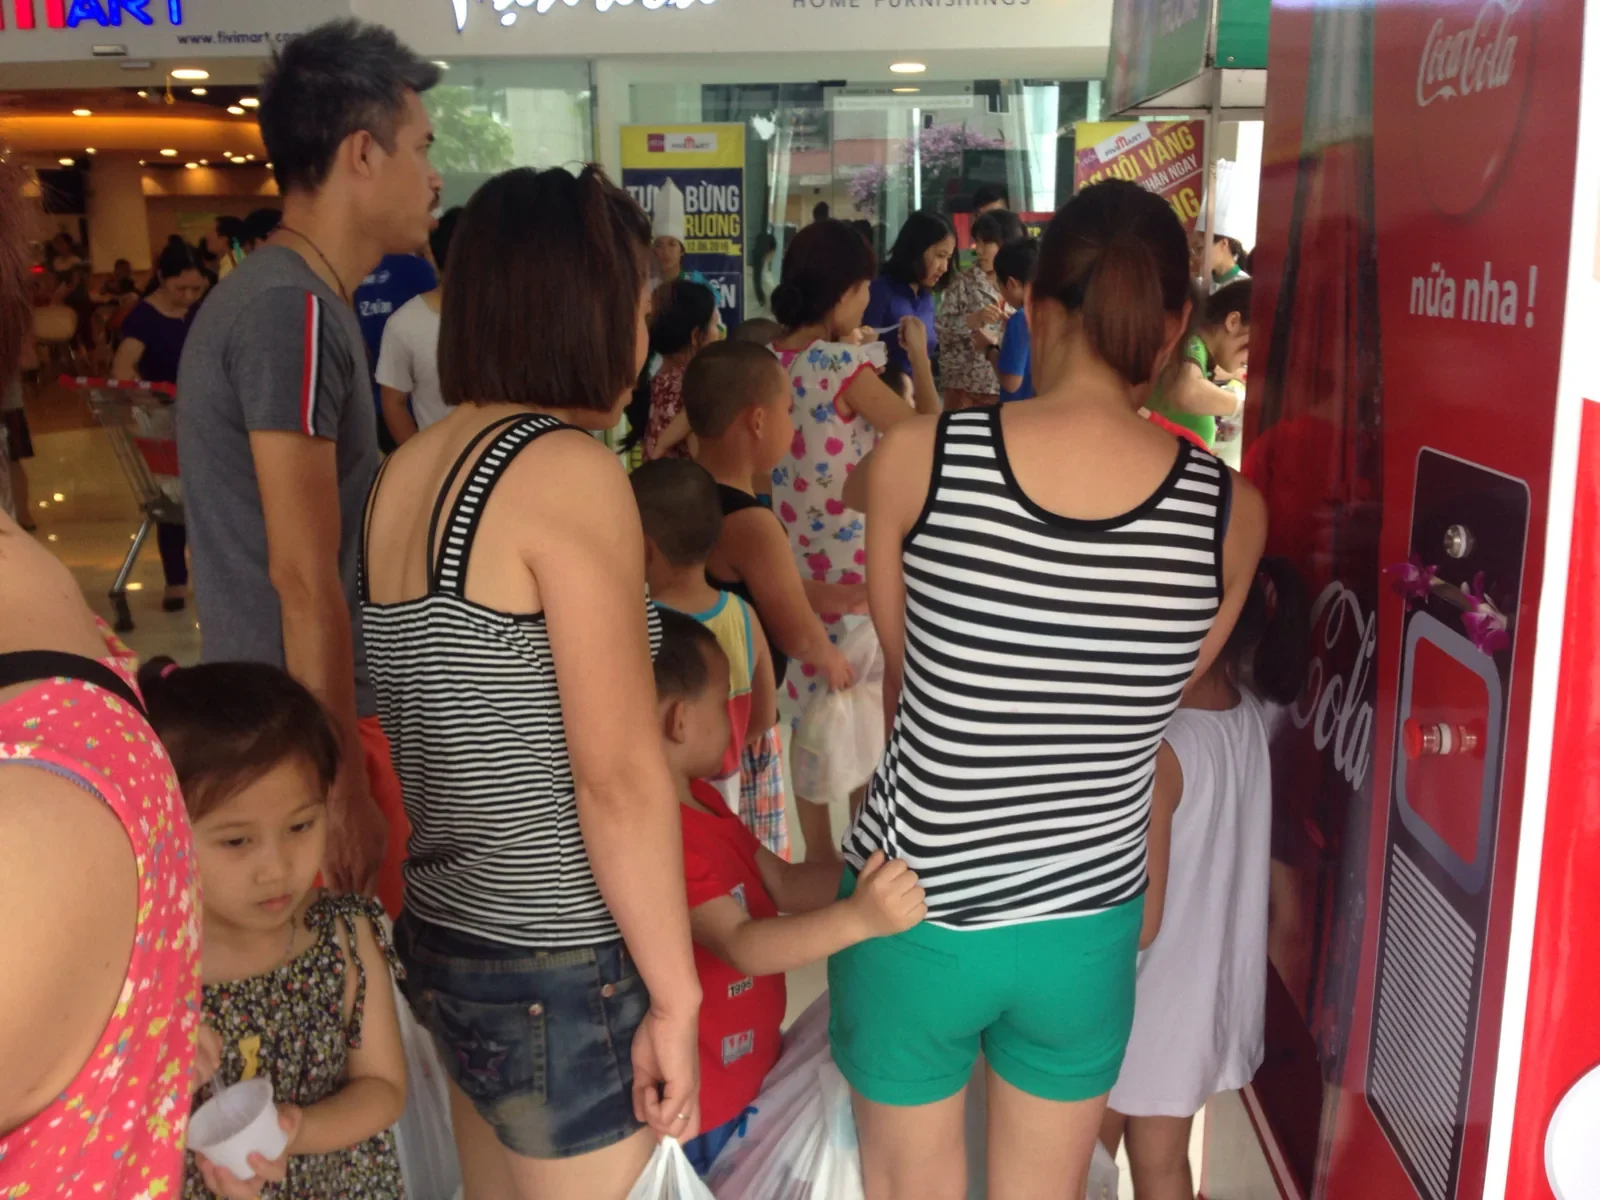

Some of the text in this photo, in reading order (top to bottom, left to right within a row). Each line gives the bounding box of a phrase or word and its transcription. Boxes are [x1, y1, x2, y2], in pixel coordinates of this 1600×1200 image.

[1139, 125, 1196, 170] VÀNG
[1168, 153, 1198, 180] NGAY
[684, 180, 740, 213] BỪNG
[684, 213, 740, 237] RƯƠNG
[1409, 262, 1456, 319] nữa
